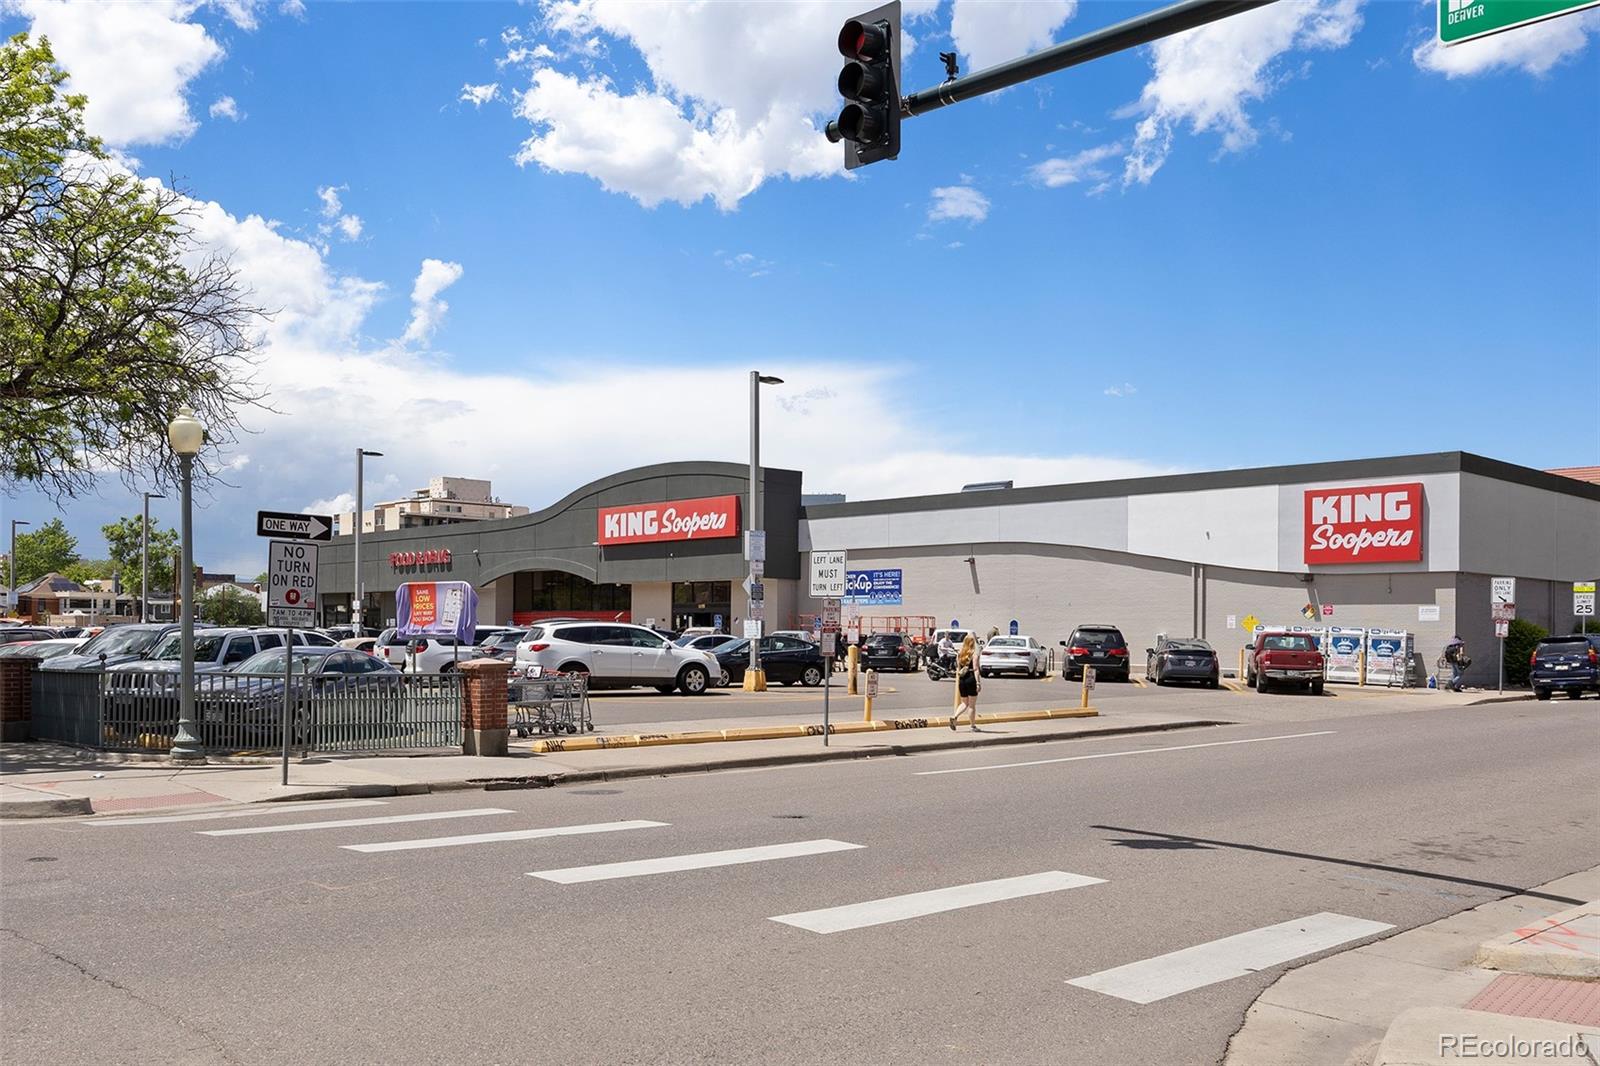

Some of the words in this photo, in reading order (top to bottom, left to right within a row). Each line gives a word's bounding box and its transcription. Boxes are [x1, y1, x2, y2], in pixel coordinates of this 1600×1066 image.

[1448, 4, 1485, 25] DENVER
[1312, 491, 1411, 525] KING
[265, 519, 286, 530] ONE
[289, 521, 310, 531] WAY
[604, 510, 658, 538] KING
[660, 508, 728, 538] Soopers
[1310, 524, 1414, 556] Soopers
[284, 546, 305, 559] NO
[391, 551, 416, 566] FOOD
[424, 549, 451, 564] DRUG
[277, 560, 311, 573] TURN
[813, 556, 826, 564] LEFT
[829, 556, 844, 564] LANE
[818, 569, 838, 578] MUST
[272, 574, 288, 586] ON
[292, 576, 315, 588] RED
[812, 583, 827, 591] TURN
[830, 583, 844, 591] LEFT
[846, 574, 872, 593] ickup
[1576, 604, 1592, 614] 25
